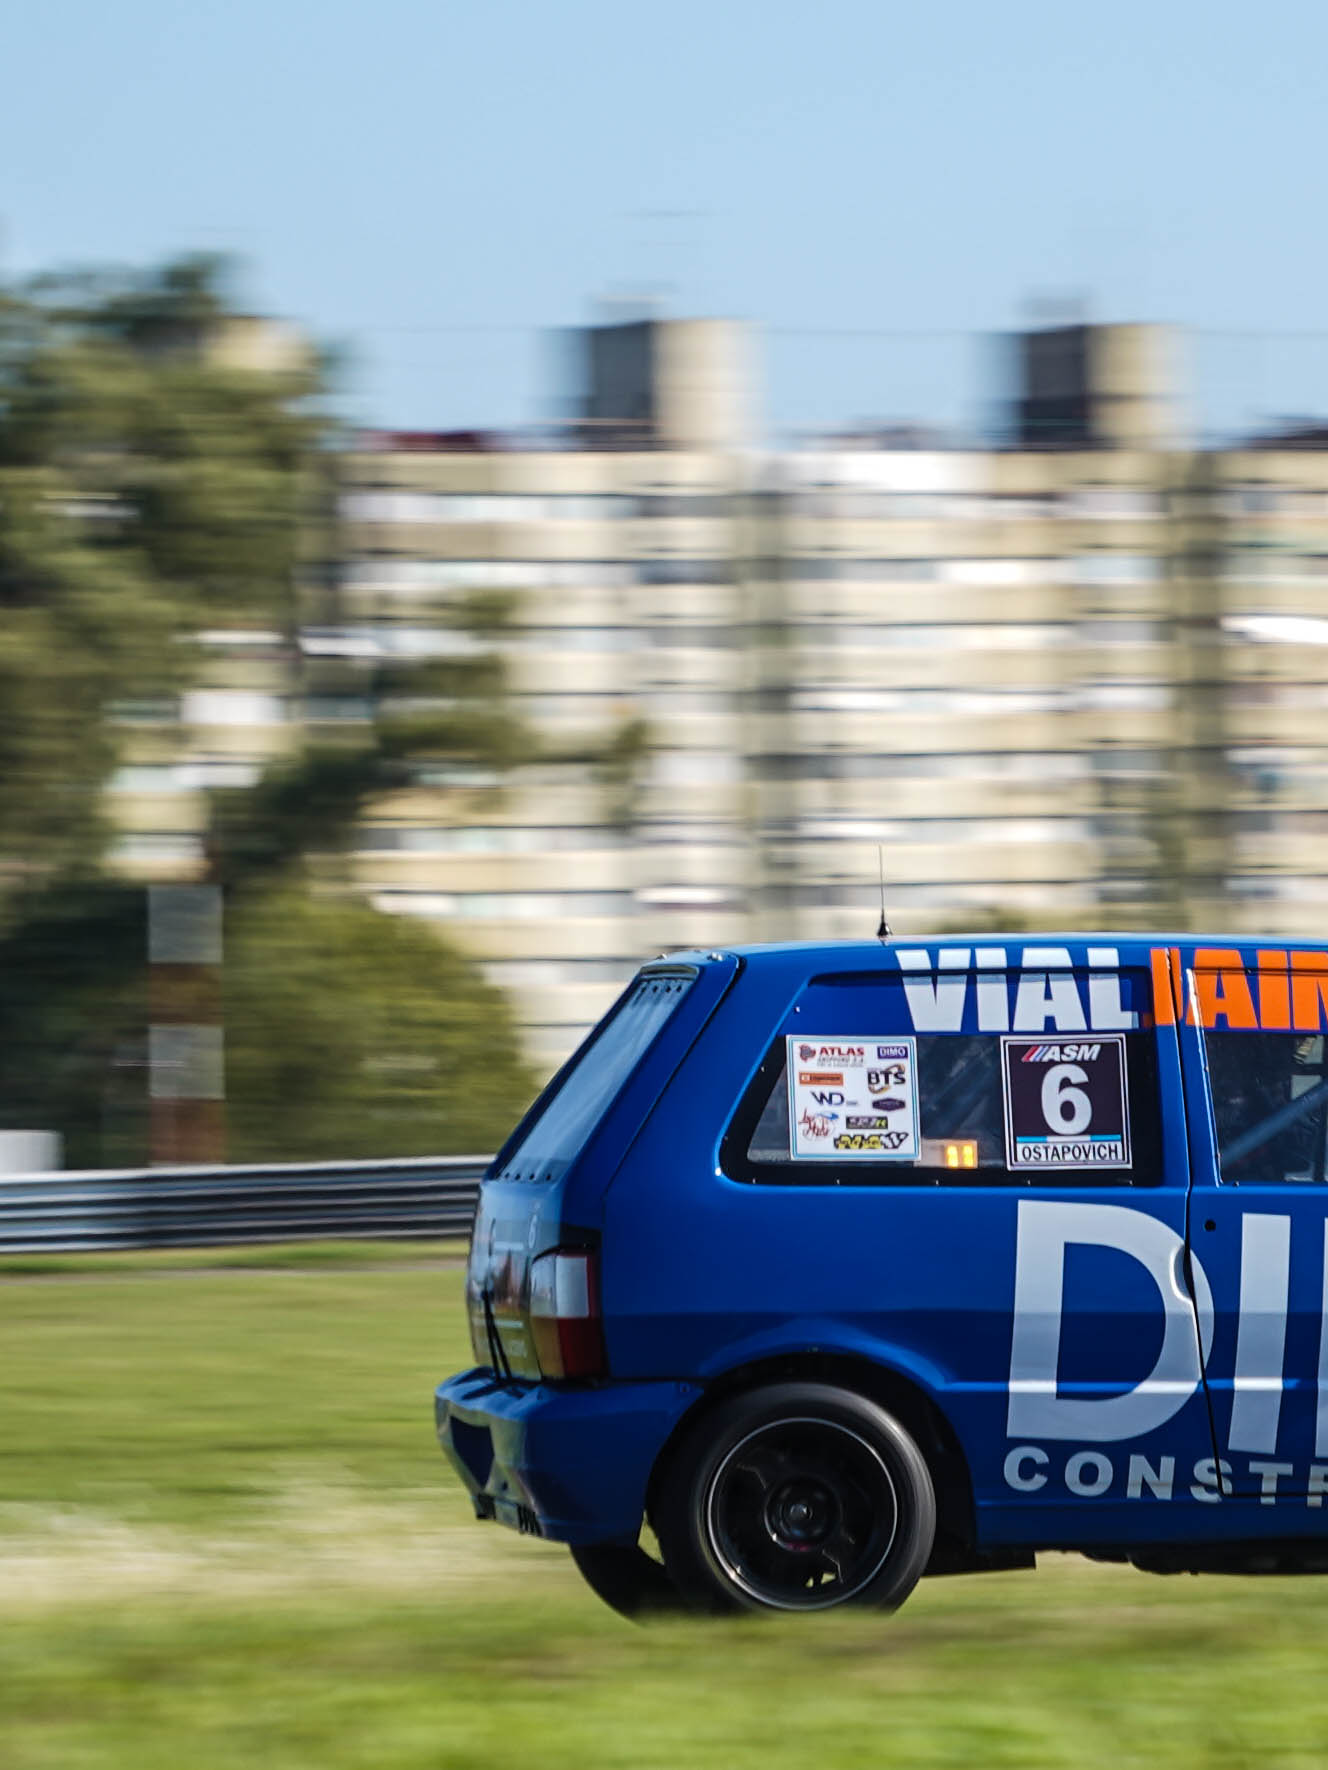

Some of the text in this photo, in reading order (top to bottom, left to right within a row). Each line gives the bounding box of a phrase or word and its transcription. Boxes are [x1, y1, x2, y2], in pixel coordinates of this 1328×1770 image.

[895, 947, 1139, 1033] VIAL
[820, 1047, 864, 1056] ATLAS
[879, 1047, 906, 1058] DIMO
[1041, 1044, 1101, 1062] ASM
[867, 1070, 907, 1085] BTS
[1041, 1063, 1092, 1135] 6
[1022, 1143, 1119, 1161] OSTAPOVICH
